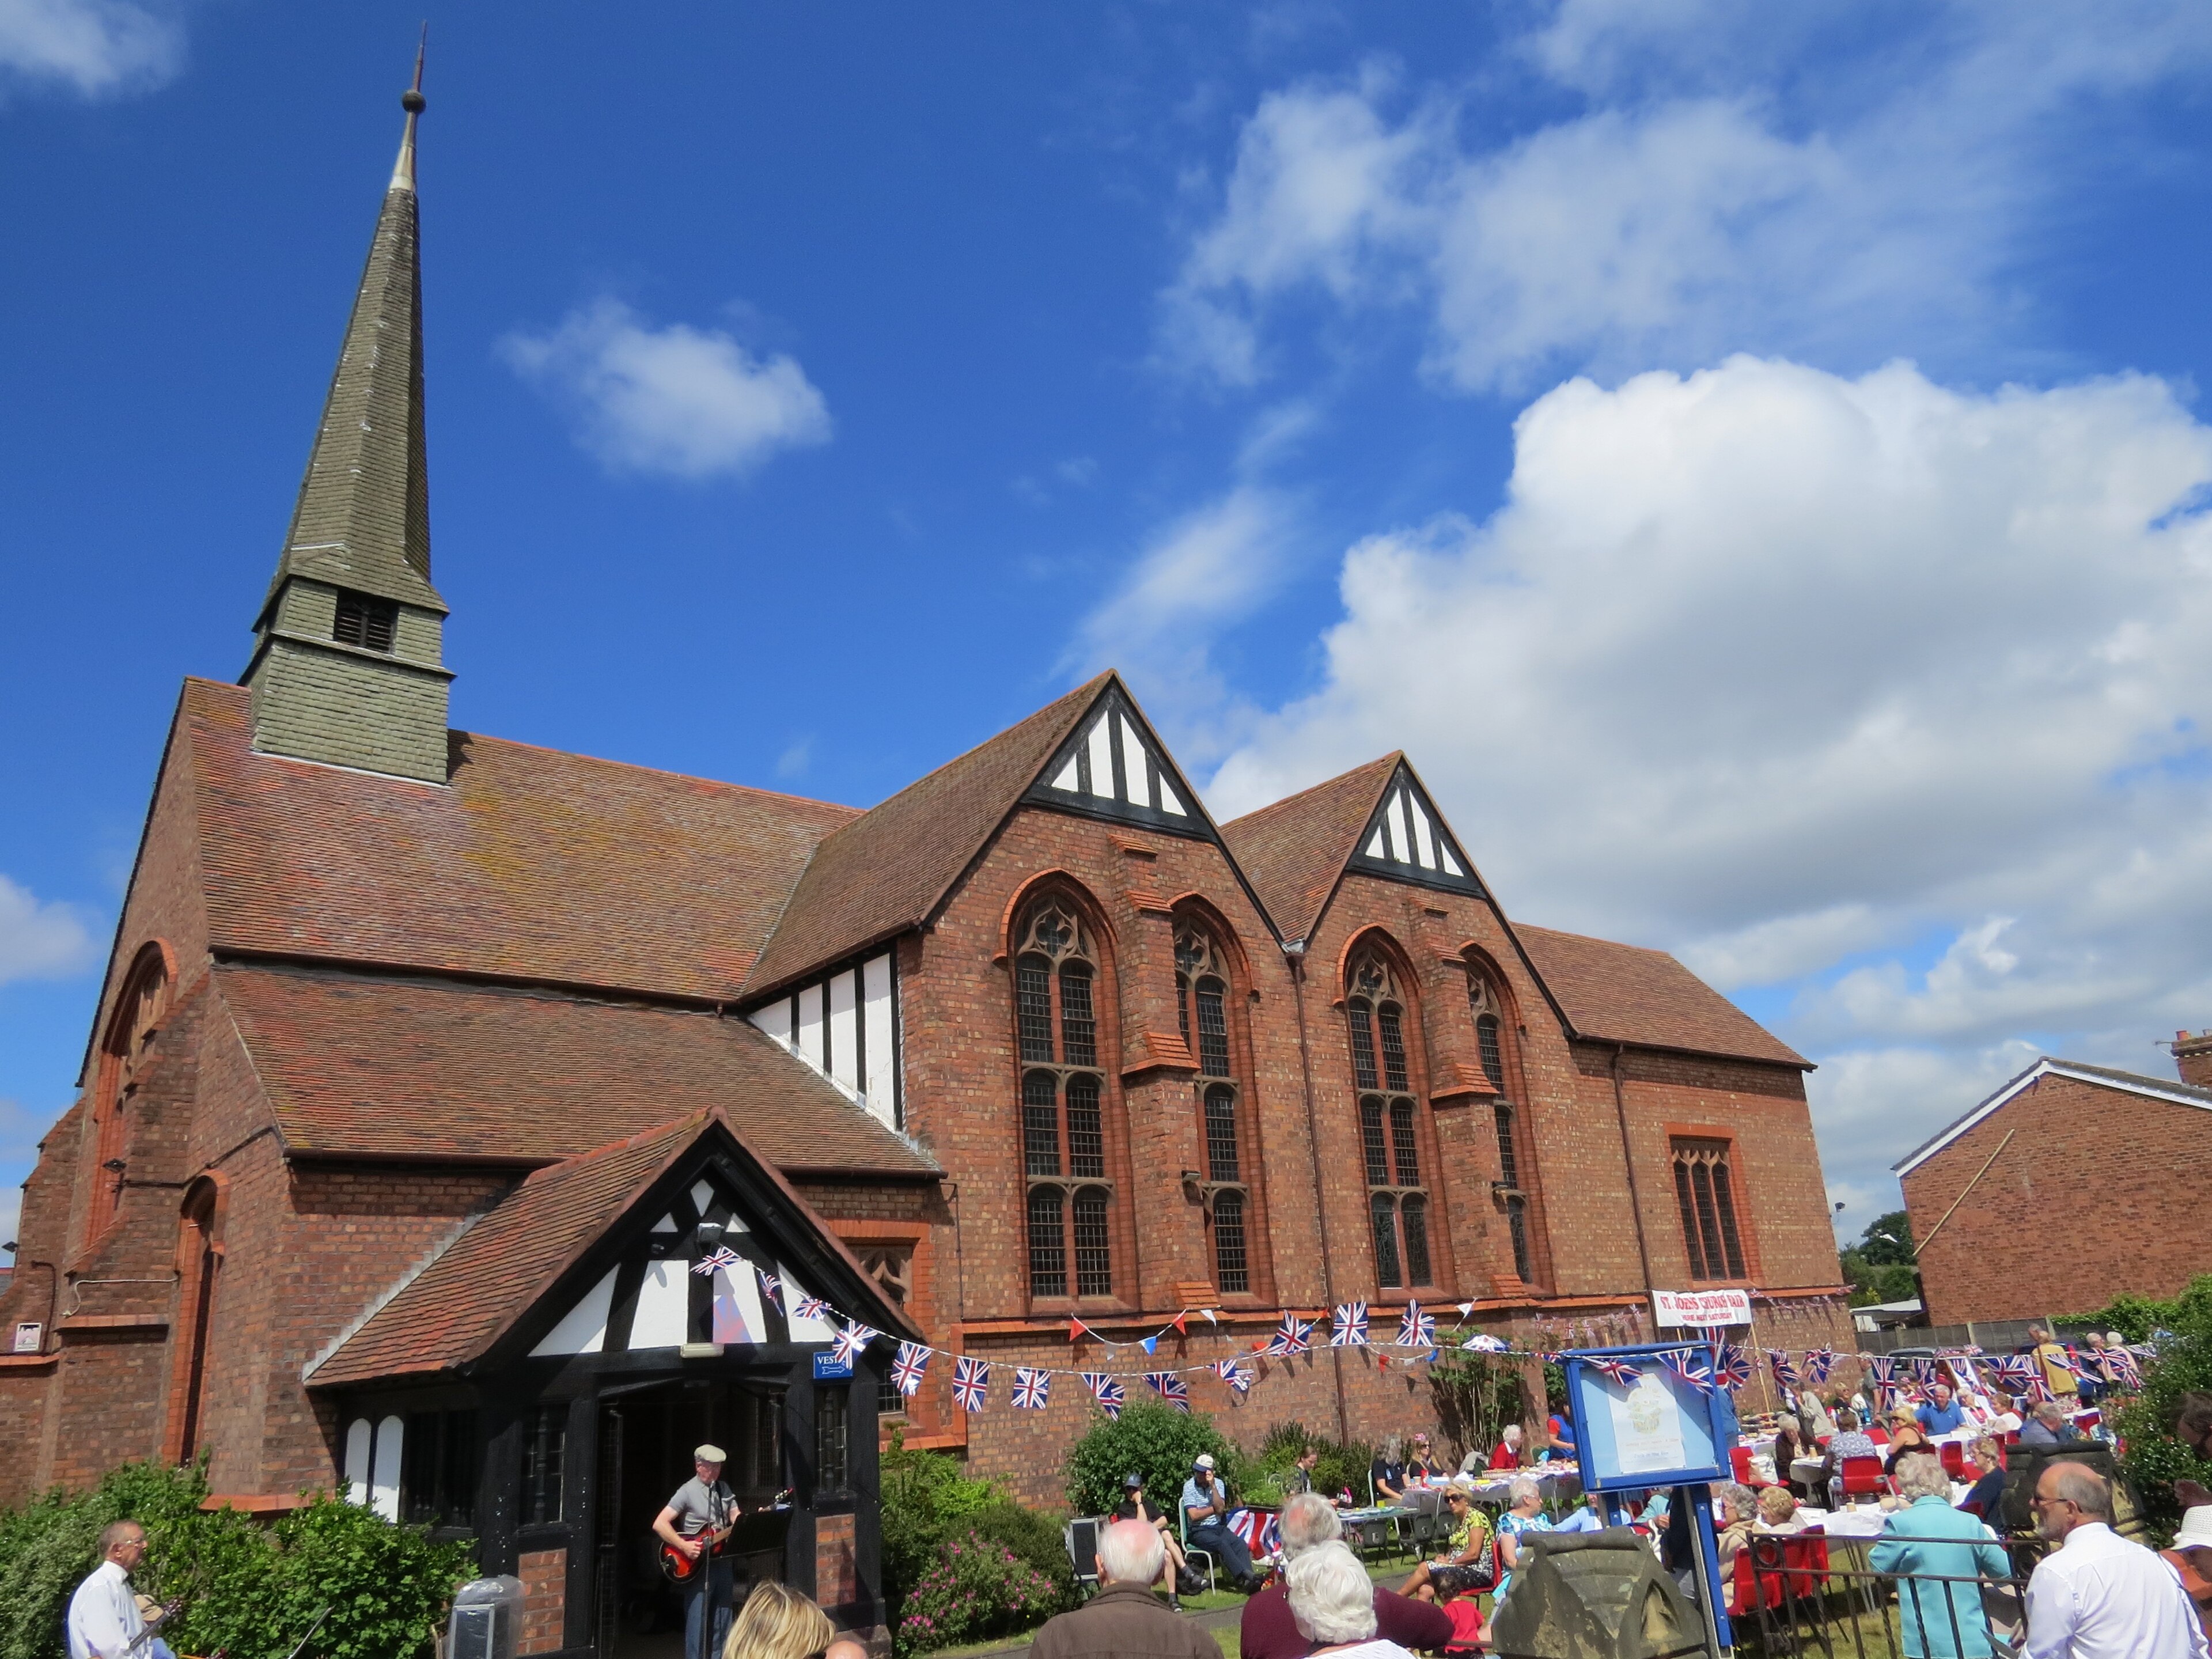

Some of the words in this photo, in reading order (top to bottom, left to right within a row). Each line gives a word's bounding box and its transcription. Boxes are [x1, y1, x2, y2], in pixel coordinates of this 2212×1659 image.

[1698, 1295, 1728, 1309] CHURCH
[1727, 1294, 1745, 1308] FAIR
[1708, 1312, 1732, 1320] SATURDAY
